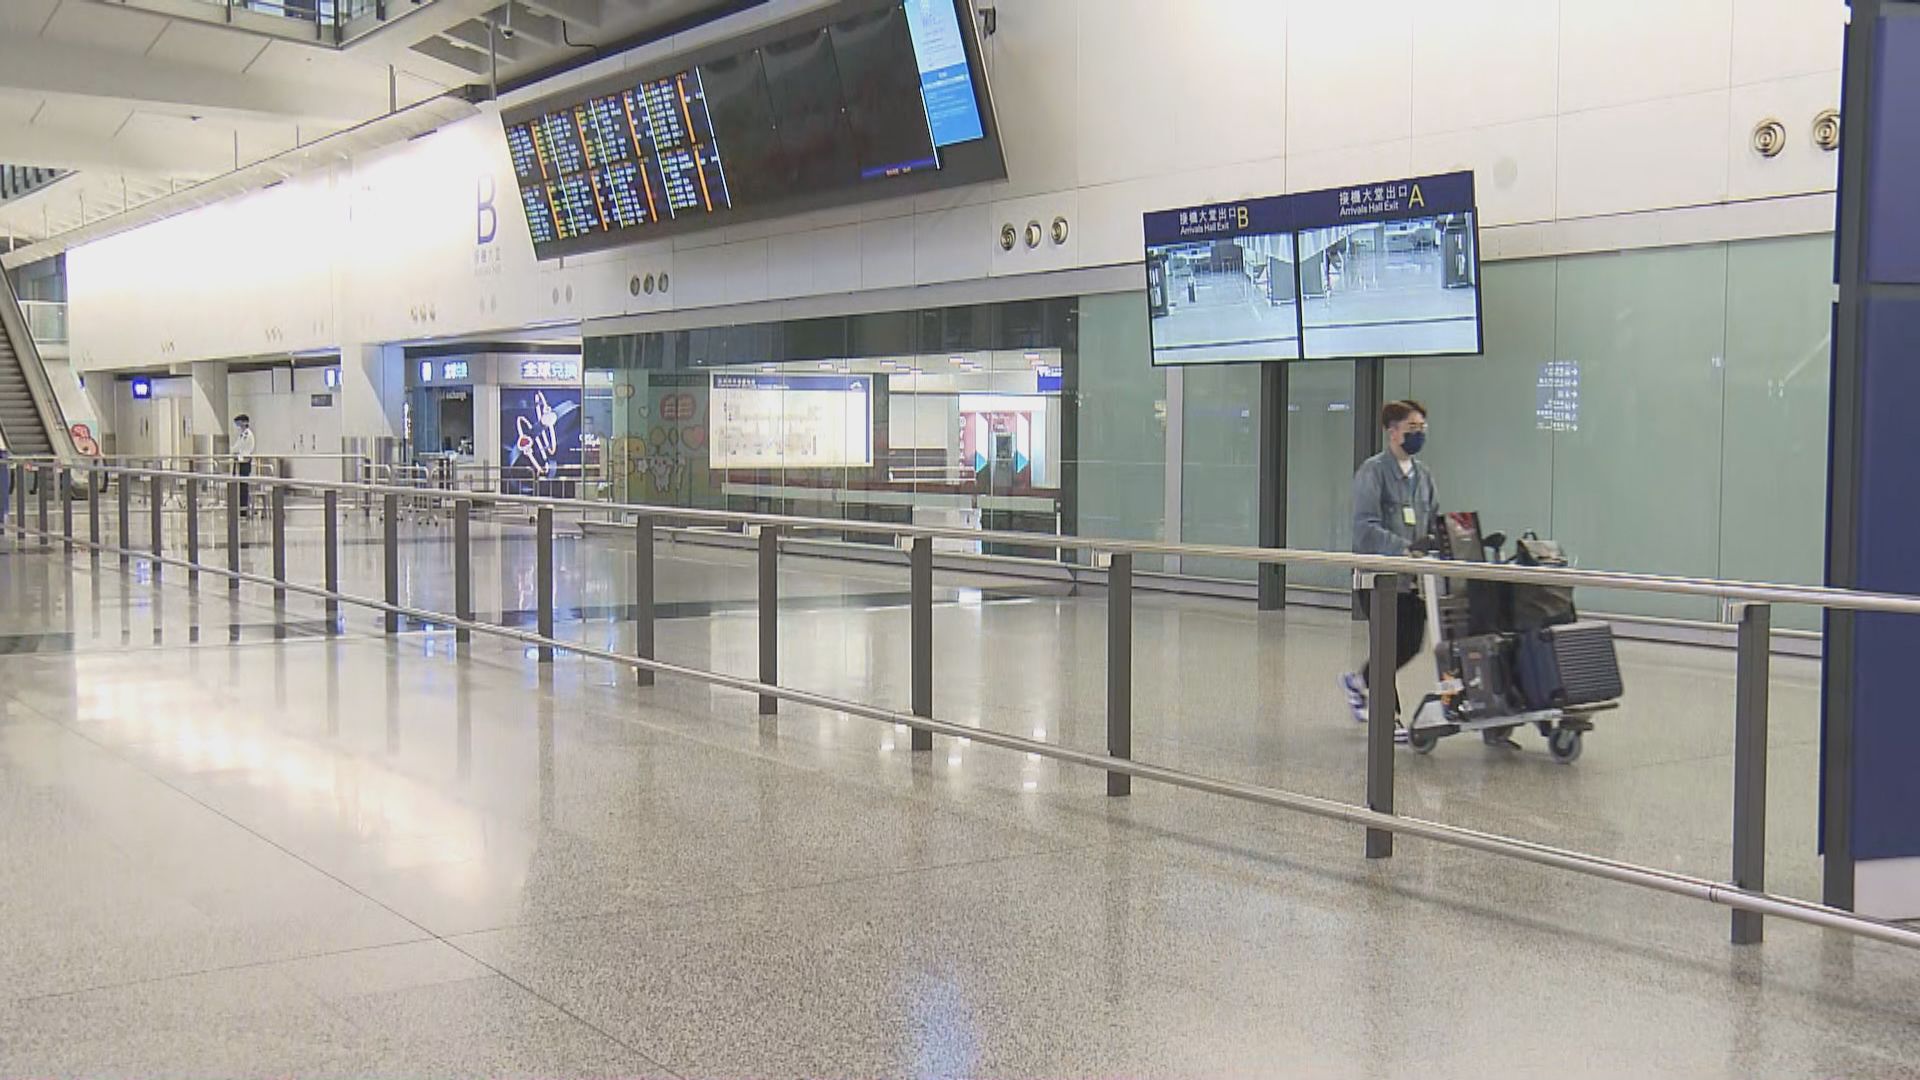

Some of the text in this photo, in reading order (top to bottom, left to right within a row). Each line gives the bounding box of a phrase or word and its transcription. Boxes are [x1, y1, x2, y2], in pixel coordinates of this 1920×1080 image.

[1339, 183, 1424, 209] 接機大堂出口 A
[1179, 206, 1249, 228] 接機大堂出口 B
[1340, 200, 1399, 216] Arrivals Hall Exit
[1180, 221, 1229, 235] Arrivals Hall Exit
